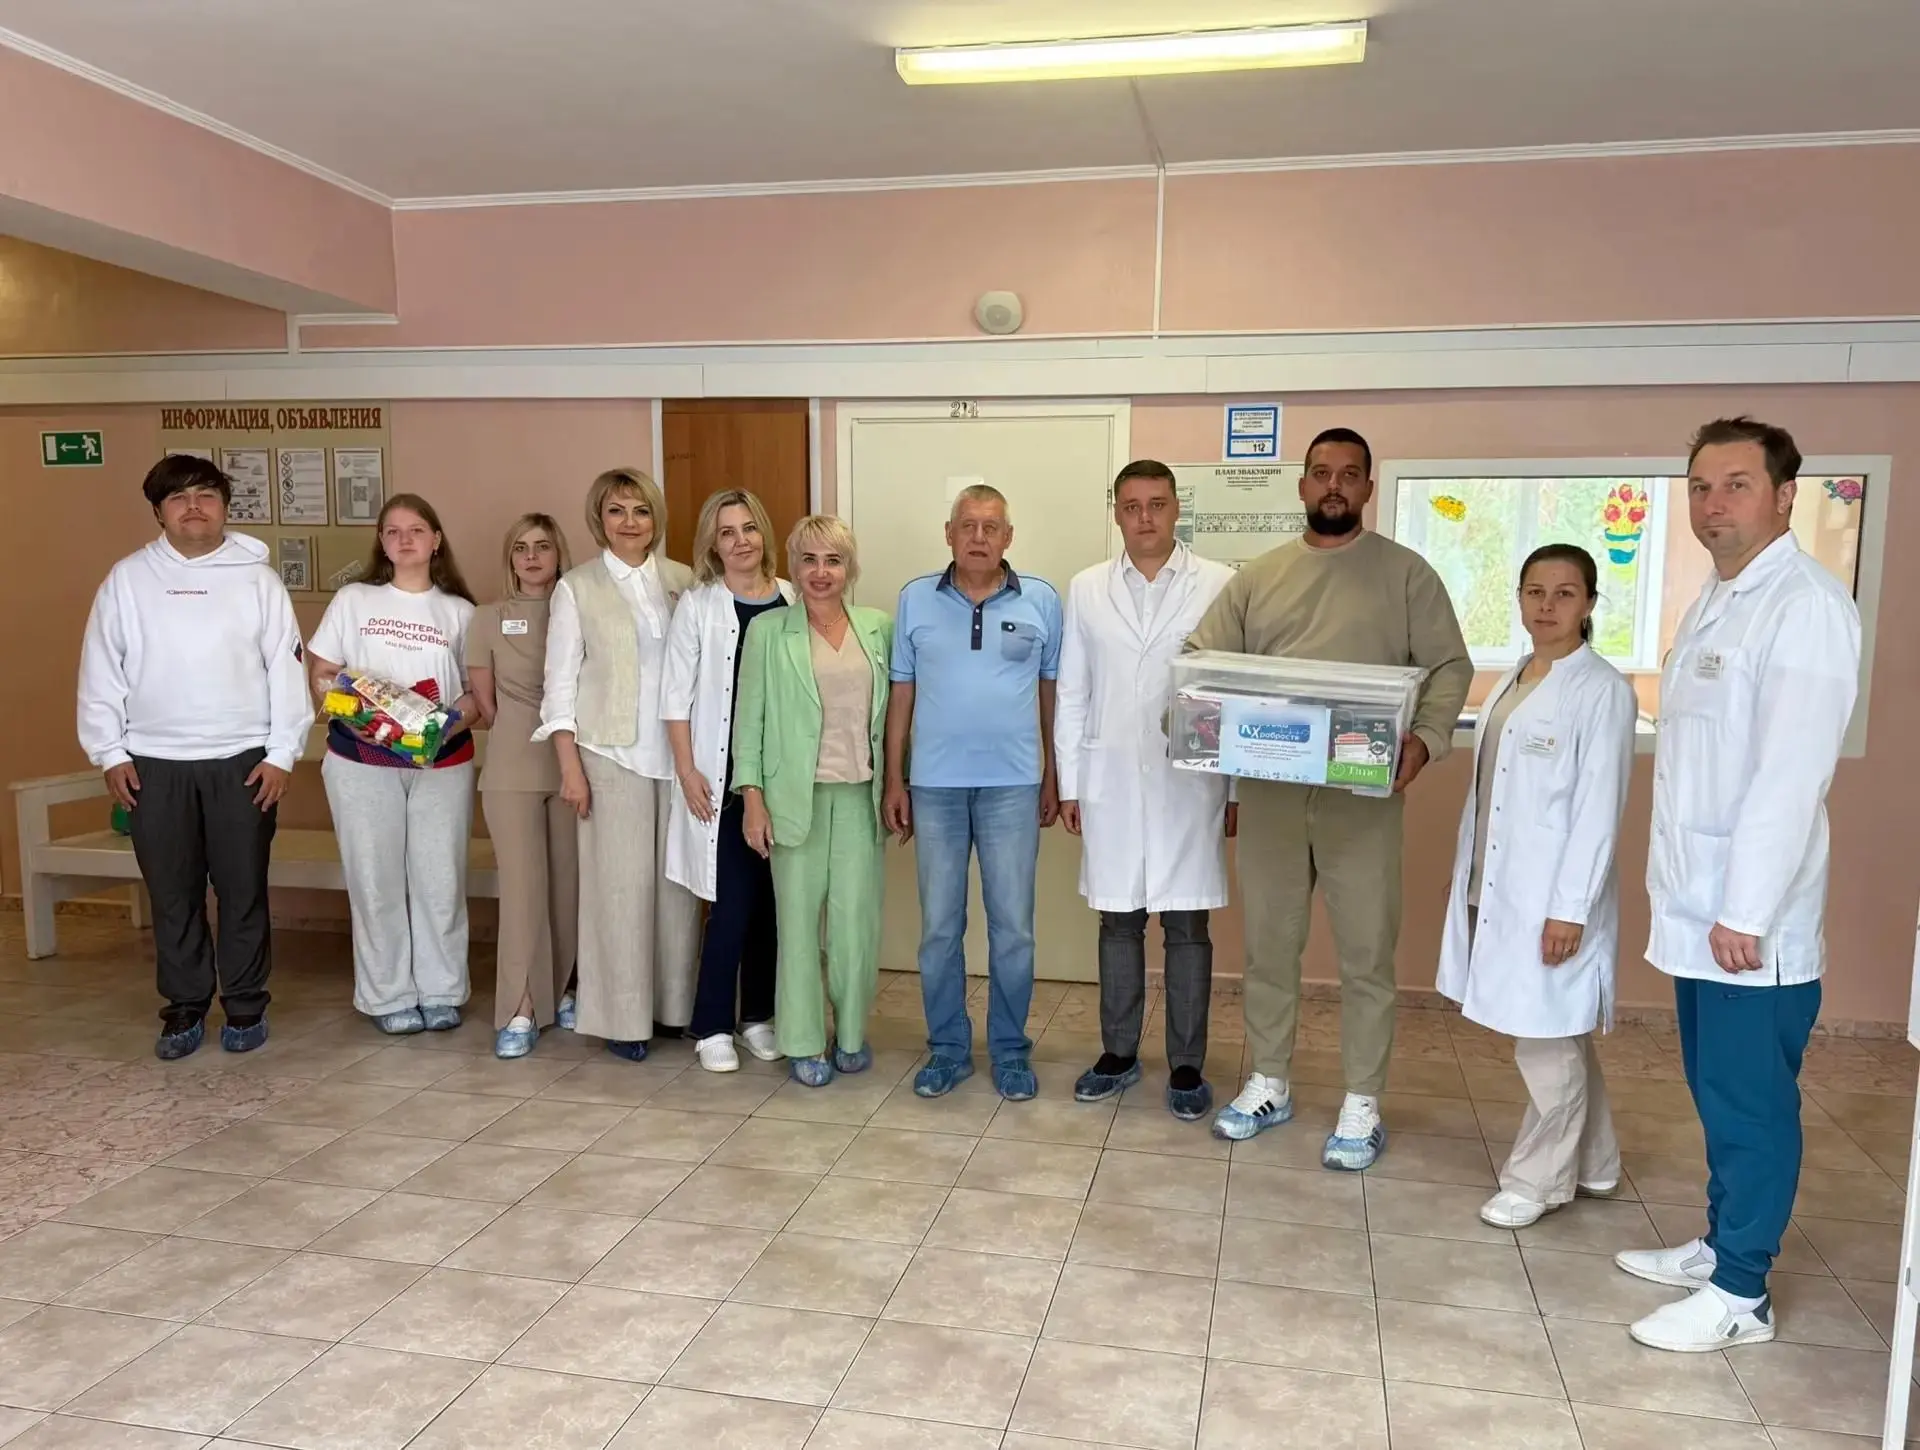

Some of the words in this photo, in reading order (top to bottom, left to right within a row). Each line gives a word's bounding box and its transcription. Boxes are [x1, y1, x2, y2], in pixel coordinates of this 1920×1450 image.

[950, 400, 979, 418] 214
[161, 408, 274, 433] ИНФОРМАЦИЯ,
[276, 407, 382, 429] ОБЪЯВЛЕНИЯ
[1253, 443, 1266, 452] 112
[368, 617, 443, 636] ВОЛОНТЕРЫ
[360, 626, 449, 648] ПОДМОСКОВЬЯ
